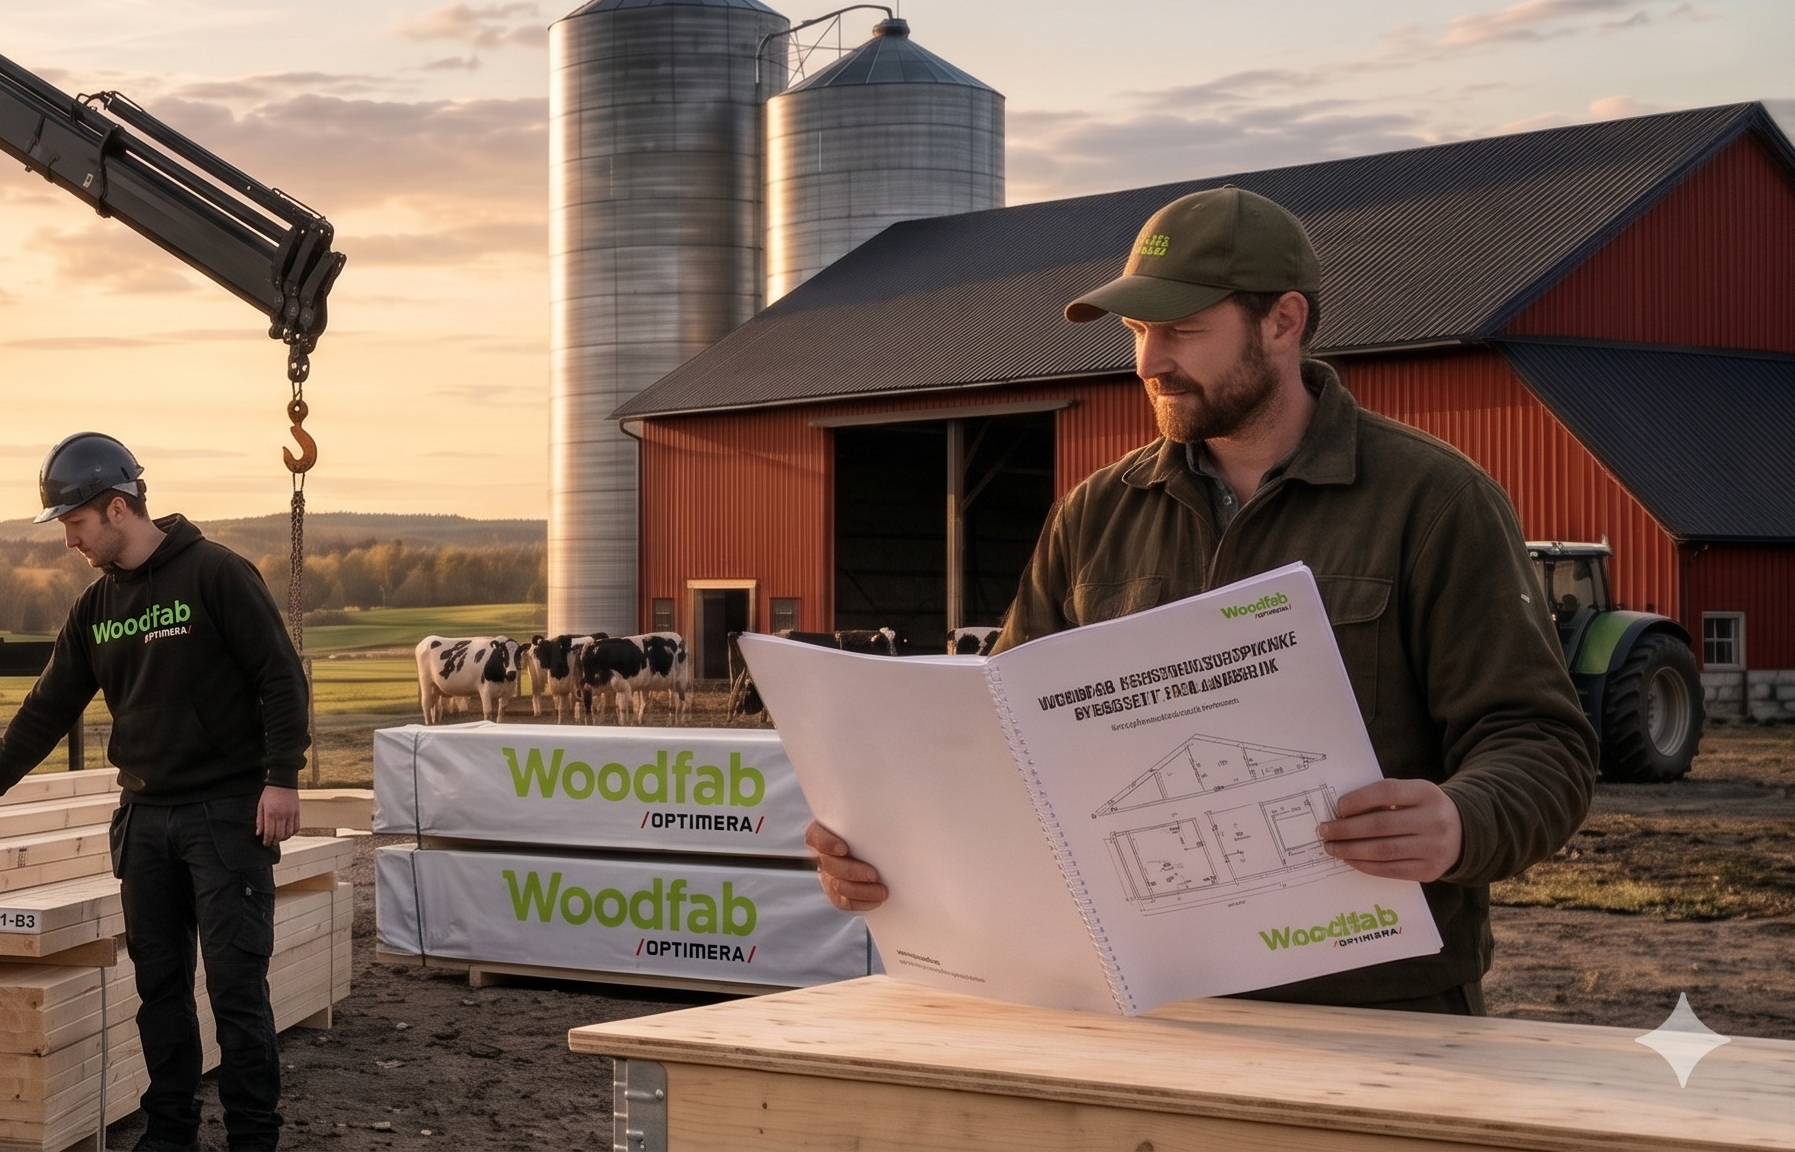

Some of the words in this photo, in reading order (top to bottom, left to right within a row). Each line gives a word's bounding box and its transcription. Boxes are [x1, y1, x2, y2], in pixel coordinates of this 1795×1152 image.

[92, 600, 191, 644] Woodfab
[502, 747, 765, 807] Woodfab
[502, 870, 757, 937] Woodfab
